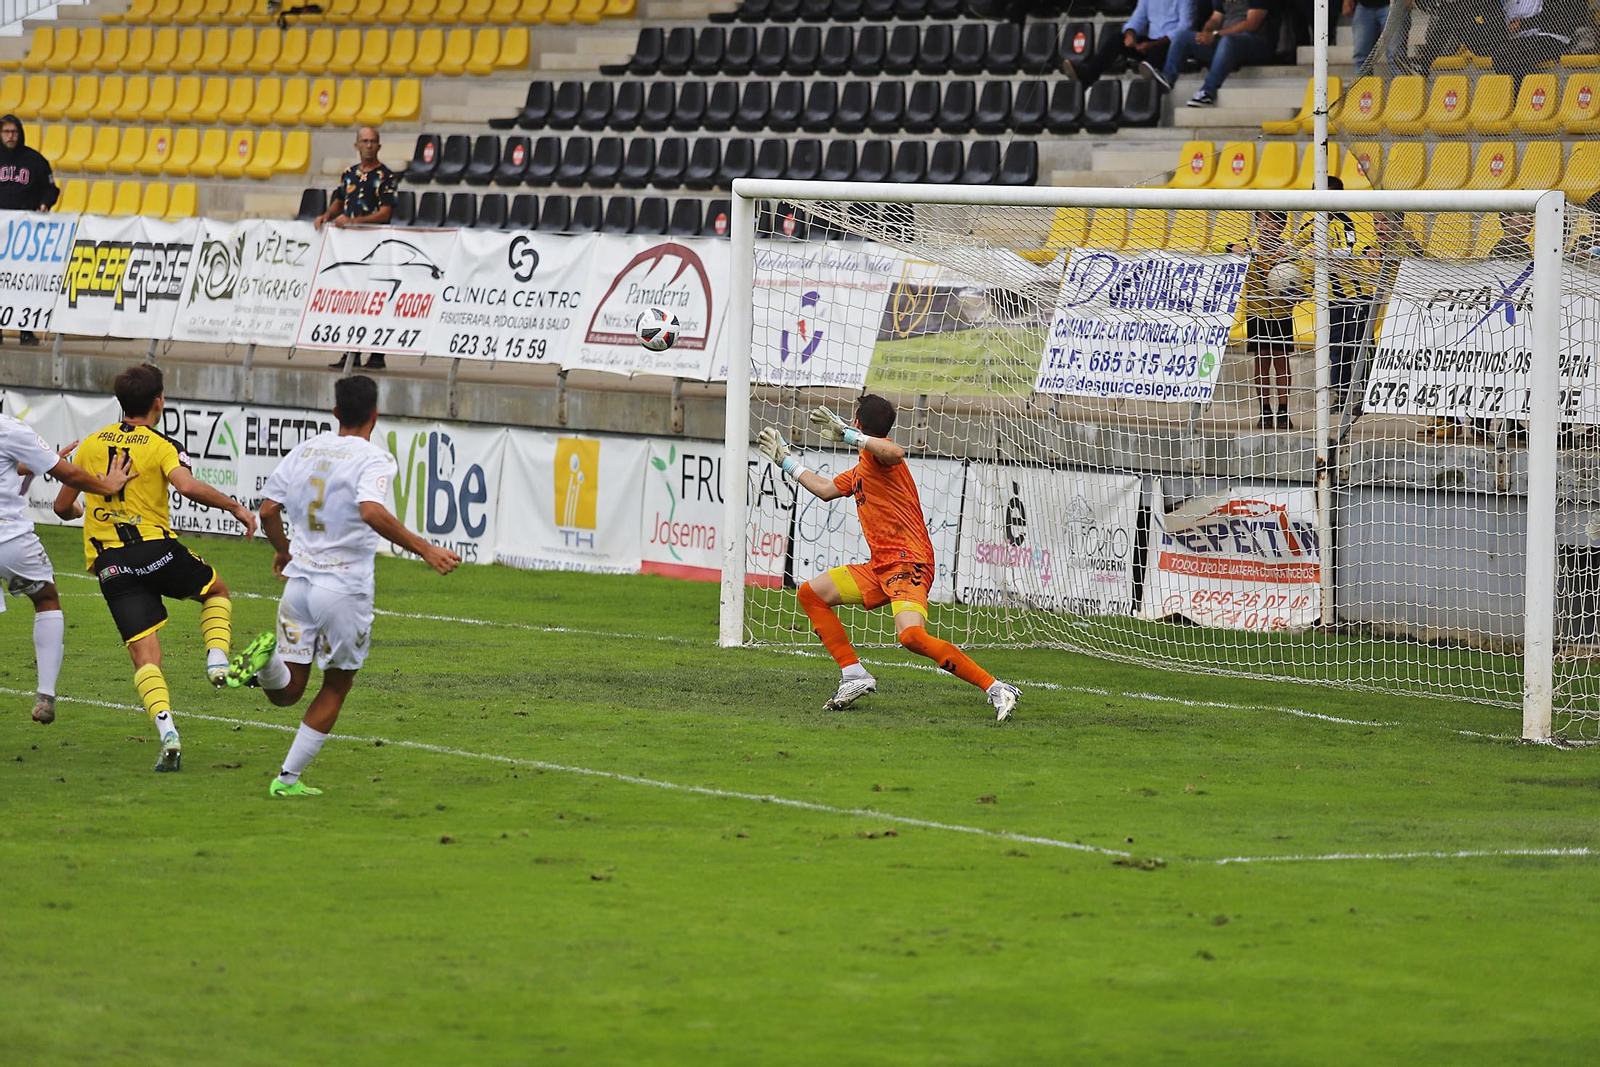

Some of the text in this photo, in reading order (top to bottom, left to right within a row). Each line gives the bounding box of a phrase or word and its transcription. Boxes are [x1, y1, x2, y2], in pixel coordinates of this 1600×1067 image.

[310, 288, 387, 316] AUTOMOVILES
[18, 307, 53, 329] 311
[311, 324, 341, 343] 636
[347, 325, 367, 344] 99
[371, 328, 395, 346] 27
[397, 329, 422, 348] 47
[449, 333, 479, 355] 623
[505, 338, 524, 358] 15
[527, 339, 547, 359] 59
[1164, 353, 1198, 377] 493
[1434, 349, 1508, 374] DEPORTIVOS
[1368, 381, 1410, 408] 676
[1412, 383, 1441, 409] 45
[1447, 385, 1473, 410] 14
[1477, 386, 1504, 413] 72
[307, 477, 326, 532] 2
[206, 517, 212, 530] 2
[650, 511, 716, 551] Josema
[559, 530, 595, 549] TH
[134, 551, 175, 577] PALMERITAS
[1171, 557, 1198, 572] TODO
[1233, 591, 1261, 608] 26
[1263, 594, 1287, 610] 07
